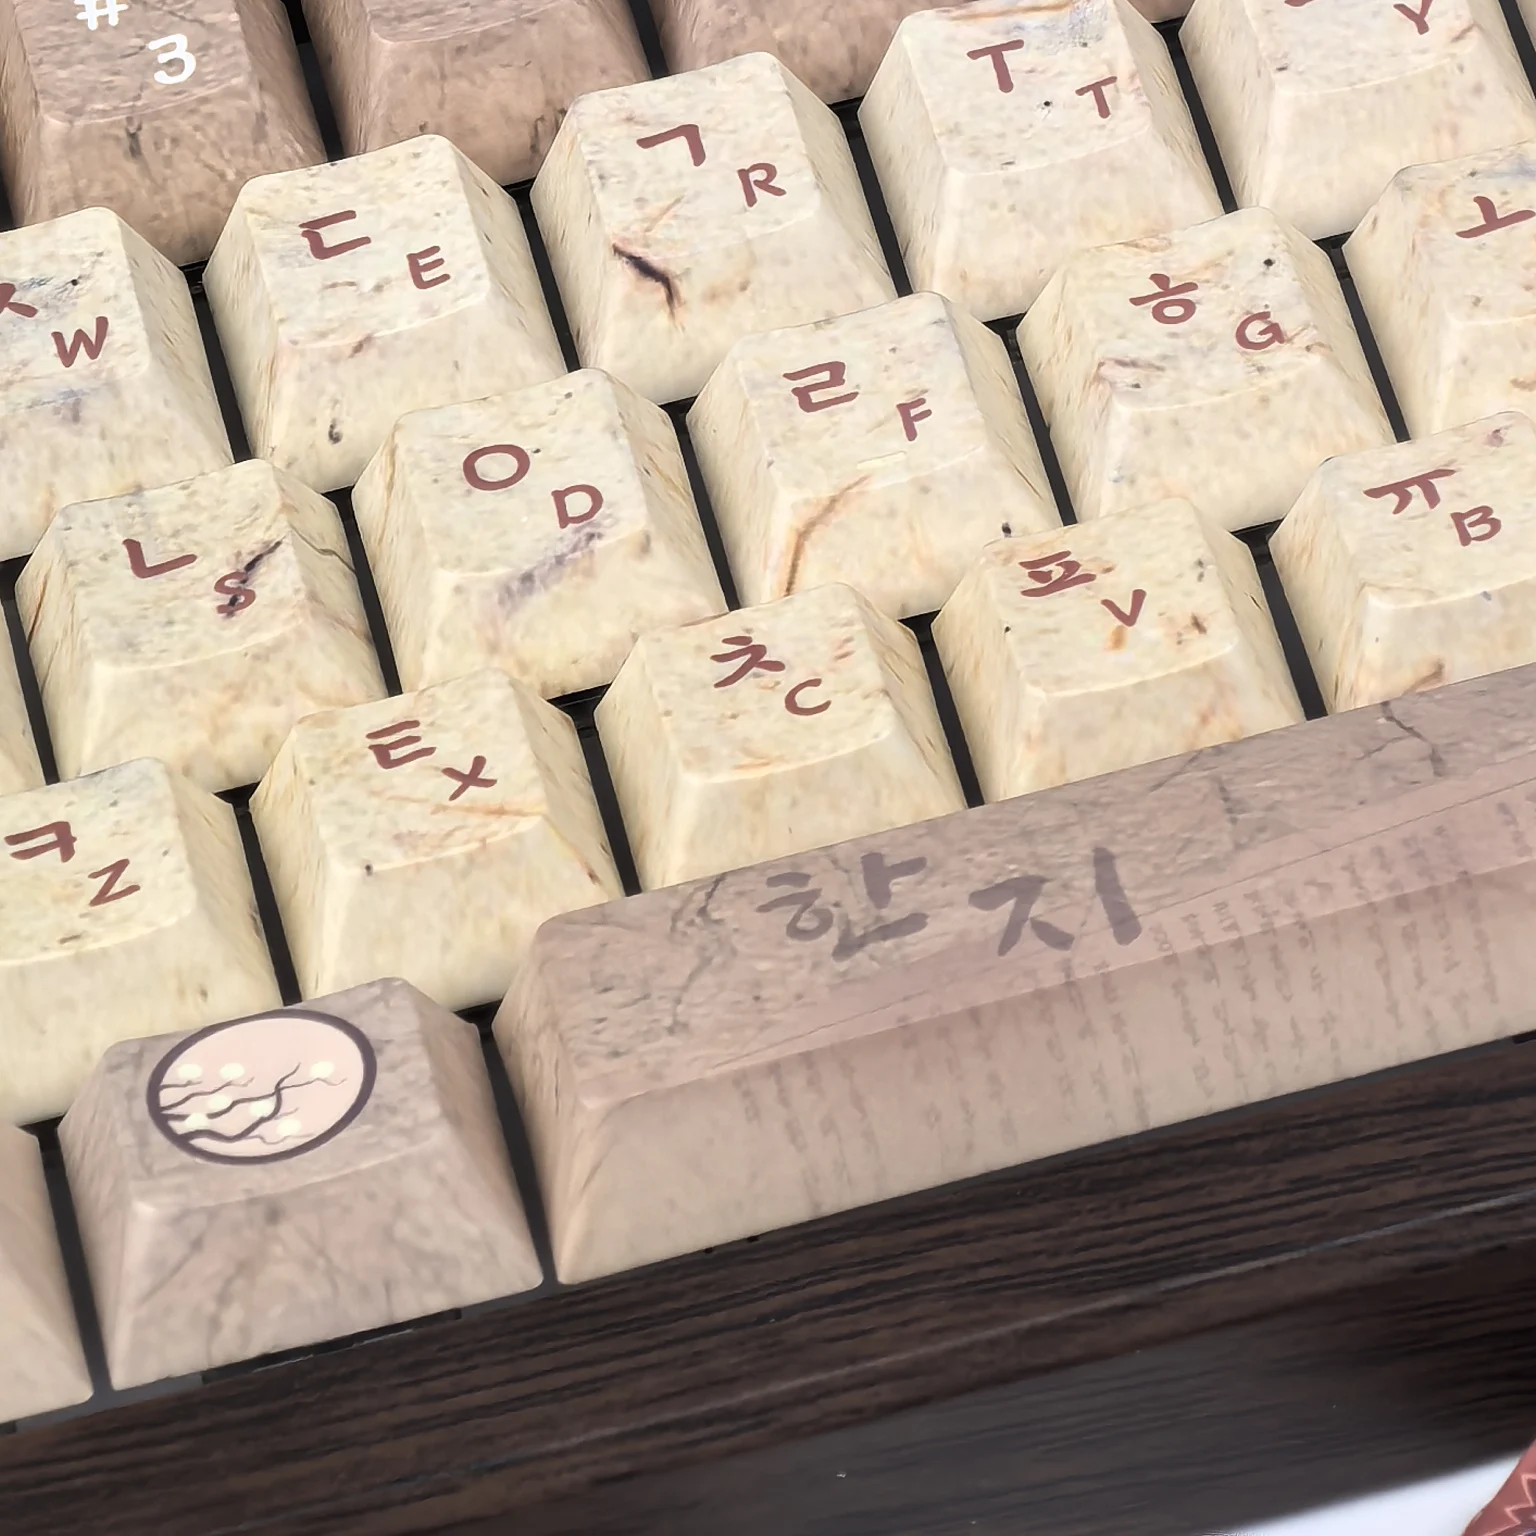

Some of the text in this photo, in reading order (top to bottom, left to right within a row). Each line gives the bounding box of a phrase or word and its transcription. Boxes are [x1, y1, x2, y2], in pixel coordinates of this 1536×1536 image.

[146, 32, 198, 86] 3
[1075, 75, 1118, 119] T
[736, 162, 786, 209] R
[406, 246, 450, 291] E
[50, 316, 109, 369] W
[1234, 310, 1287, 352] G
[895, 397, 931, 442] F
[550, 483, 604, 530] D
[1449, 504, 1502, 548] B
[213, 569, 257, 616] S
[1099, 588, 1146, 628] V
[783, 677, 831, 717] C
[440, 754, 497, 802] X
[88, 858, 141, 907] Z
